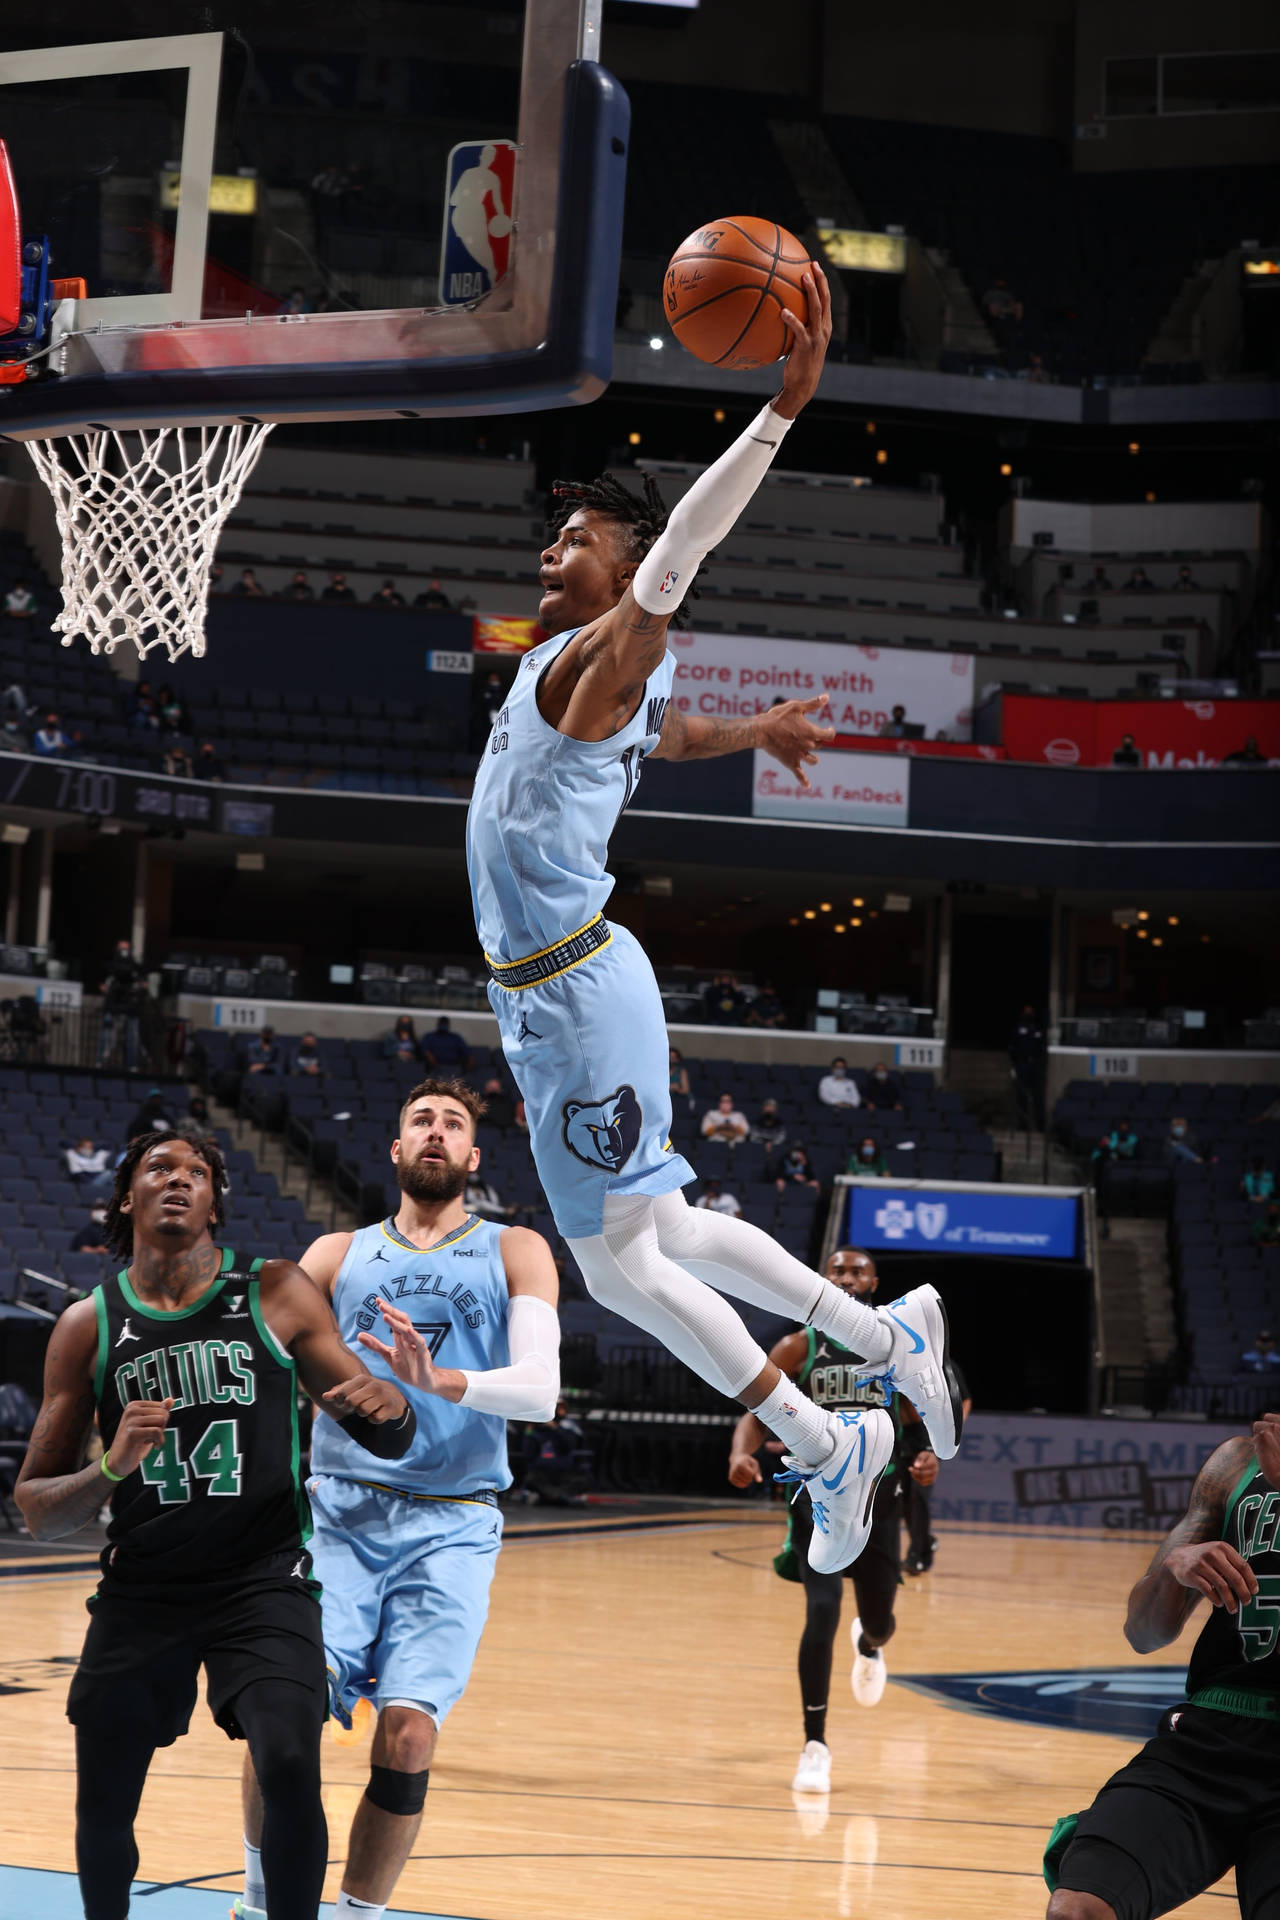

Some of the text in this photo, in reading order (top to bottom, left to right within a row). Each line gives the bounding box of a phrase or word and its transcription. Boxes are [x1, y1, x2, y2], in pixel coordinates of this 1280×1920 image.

[449, 272, 482, 298] NBA
[435, 655, 469, 669] 112A
[676, 664, 874, 694] core points with
[841, 704, 889, 730] App
[832, 784, 904, 805] FanDeck
[230, 1008, 257, 1025] 111
[909, 1048, 934, 1065] 111
[1104, 1058, 1129, 1074] 110
[355, 1274, 486, 1331] GRIZZLIES
[114, 1340, 257, 1412] CELTICS
[140, 1419, 244, 1505] 44
[961, 1433, 1053, 1465] EXT
